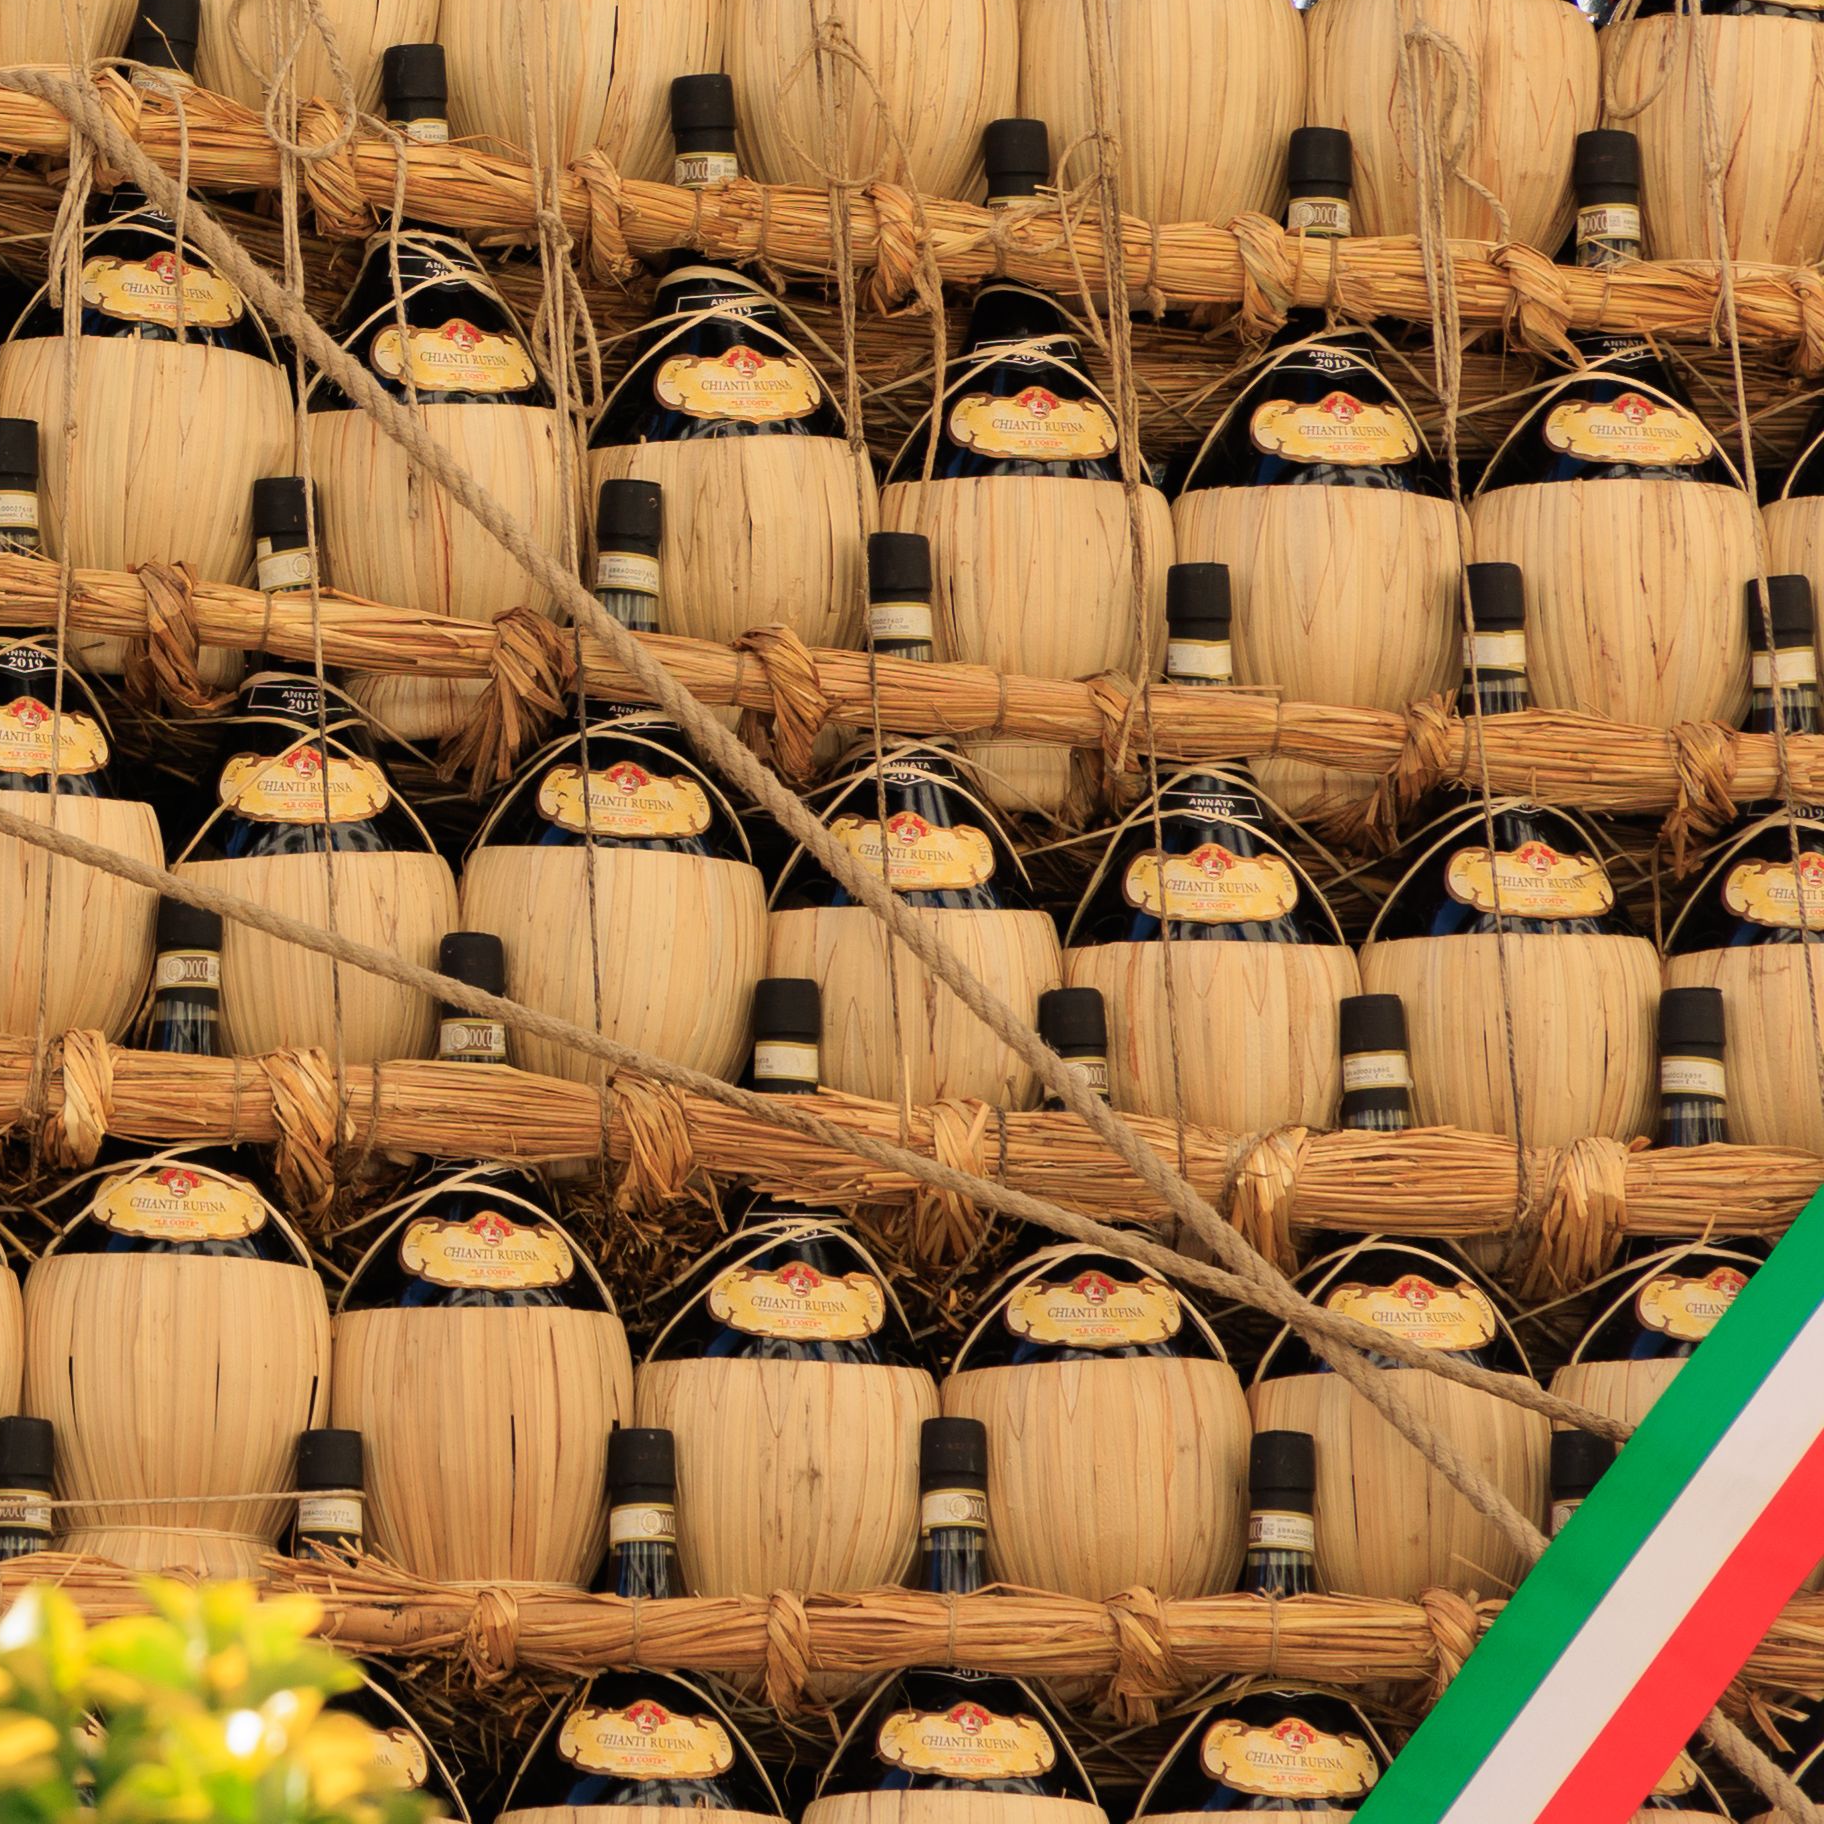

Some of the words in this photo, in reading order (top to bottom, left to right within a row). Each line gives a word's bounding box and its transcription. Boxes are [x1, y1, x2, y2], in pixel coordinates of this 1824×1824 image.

[122, 281, 171, 296] CHIANTI
[176, 287, 214, 301] UFINA
[420, 351, 470, 364] CHIANTI
[472, 355, 509, 367] RUFINA
[1315, 358, 1351, 369] 2019
[701, 379, 751, 391] CHIANTI
[754, 380, 793, 391] RUFINA
[992, 418, 1042, 431] CHIANTI
[1044, 422, 1086, 434] RUFINA
[1298, 424, 1349, 436] CHIANTI
[1350, 427, 1391, 437] RUFINA
[1589, 423, 1639, 436] CHIANTI
[1641, 427, 1682, 439] RUFINA
[7, 656, 45, 669] 2019
[257, 780, 307, 792] CHIANTI
[631, 798, 675, 812] RUFINA
[1188, 798, 1236, 808] ANNATA
[910, 849, 955, 863] RUFINA
[1165, 879, 1215, 892] CHIANTI
[1218, 882, 1262, 895] RUFINA
[129, 1196, 180, 1210] CHIANTI
[182, 1201, 227, 1213] RUFINA
[444, 1246, 494, 1260] CHIANTI
[497, 1250, 541, 1262] RUFINA
[751, 1295, 802, 1310] CHIANTI
[805, 1300, 849, 1314] RUFINA
[1047, 1307, 1099, 1318] CHIANTI
[1101, 1308, 1146, 1318] RUFINA
[1372, 1310, 1423, 1322] CHIANTI
[1424, 1313, 1466, 1324] RUFINA
[596, 1733, 648, 1747] CHIANTI
[650, 1737, 695, 1751] RUFINA
[922, 1734, 973, 1748] CHIANTI
[976, 1738, 1021, 1750] RUFINA
[1246, 1750, 1297, 1766] CHIANTI
[1300, 1756, 1345, 1771] RUFINA
